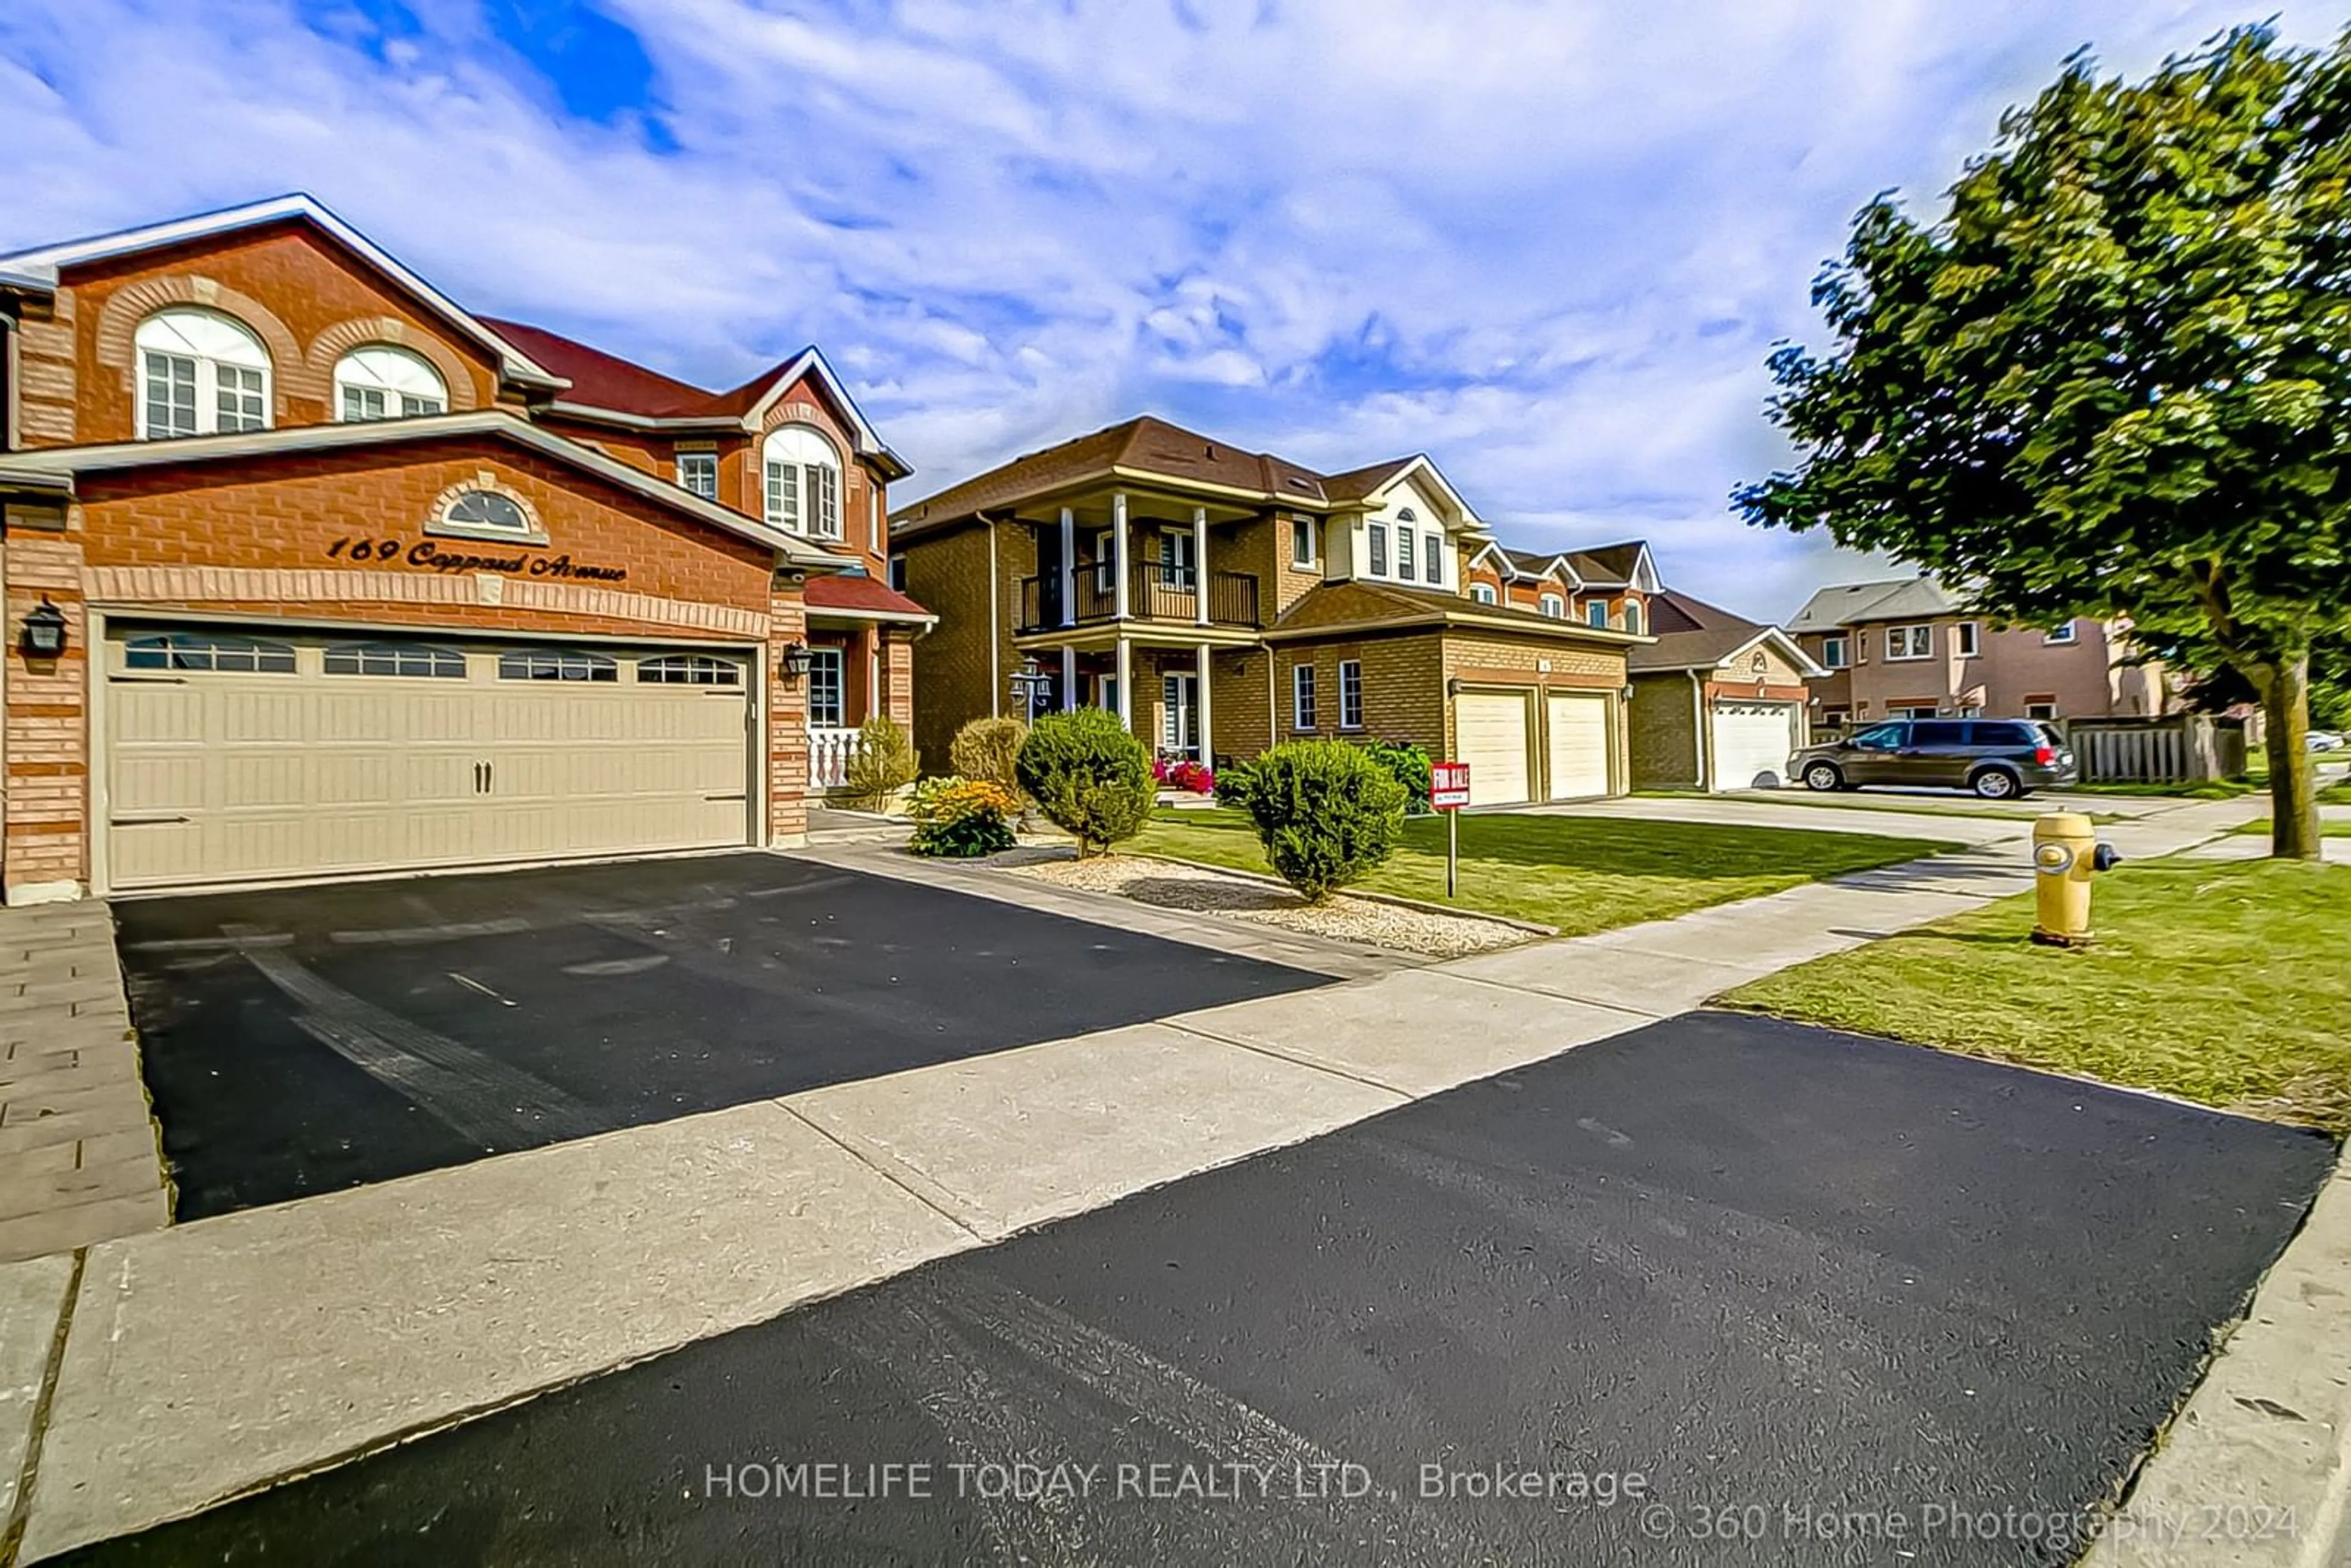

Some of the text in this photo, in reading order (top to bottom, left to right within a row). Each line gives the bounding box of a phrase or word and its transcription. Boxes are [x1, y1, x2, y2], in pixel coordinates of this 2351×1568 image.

[326, 536, 626, 582] 169 Coppard Avenue
[1434, 767, 1469, 789] FOR SALE
